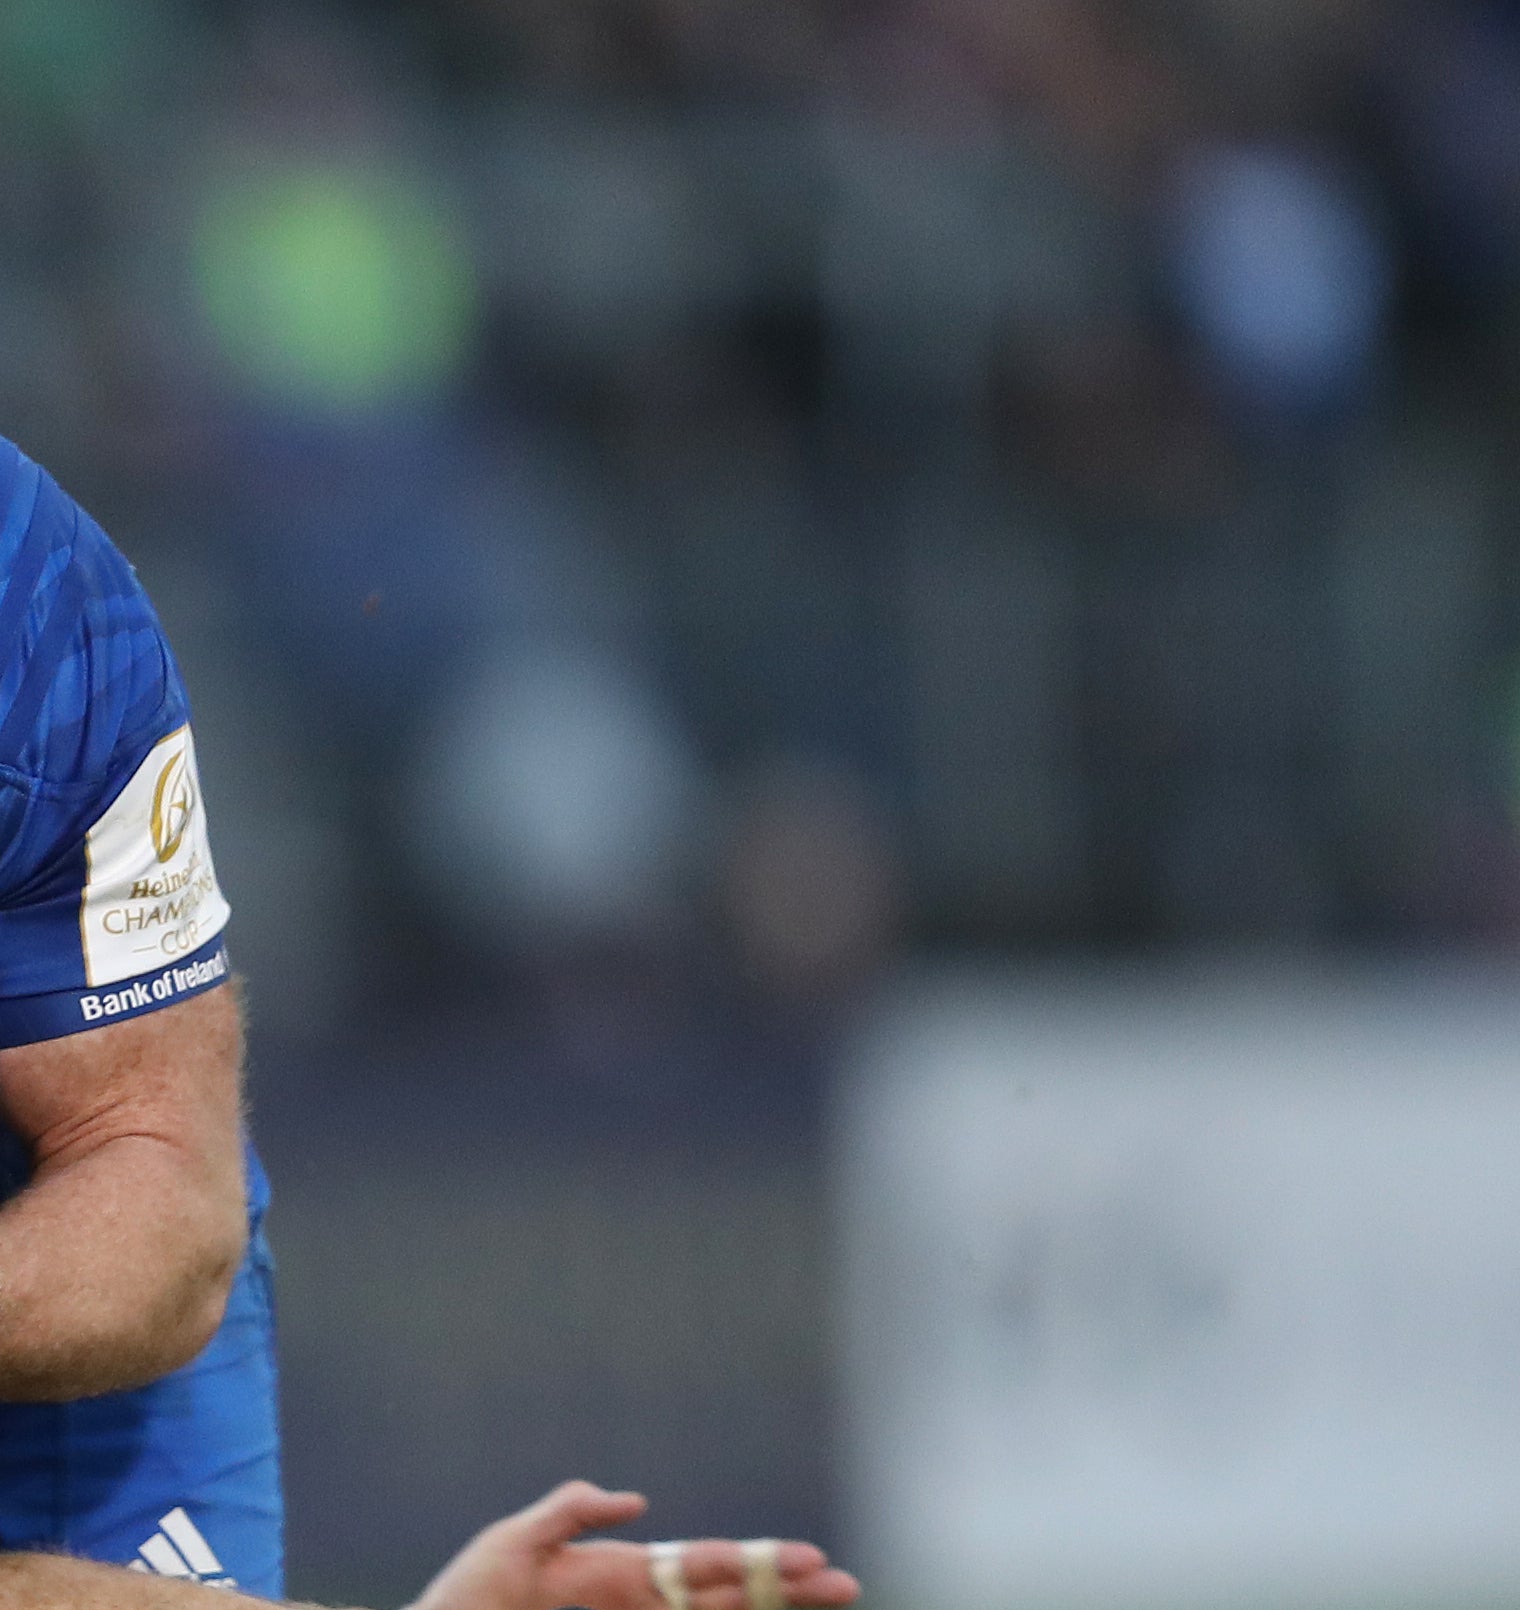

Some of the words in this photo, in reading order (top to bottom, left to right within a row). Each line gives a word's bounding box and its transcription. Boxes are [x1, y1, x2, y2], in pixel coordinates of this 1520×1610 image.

[161, 920, 198, 955] CUP
[80, 981, 154, 1021] Bank
[152, 970, 176, 1001] of
[174, 951, 225, 993] Ireland
